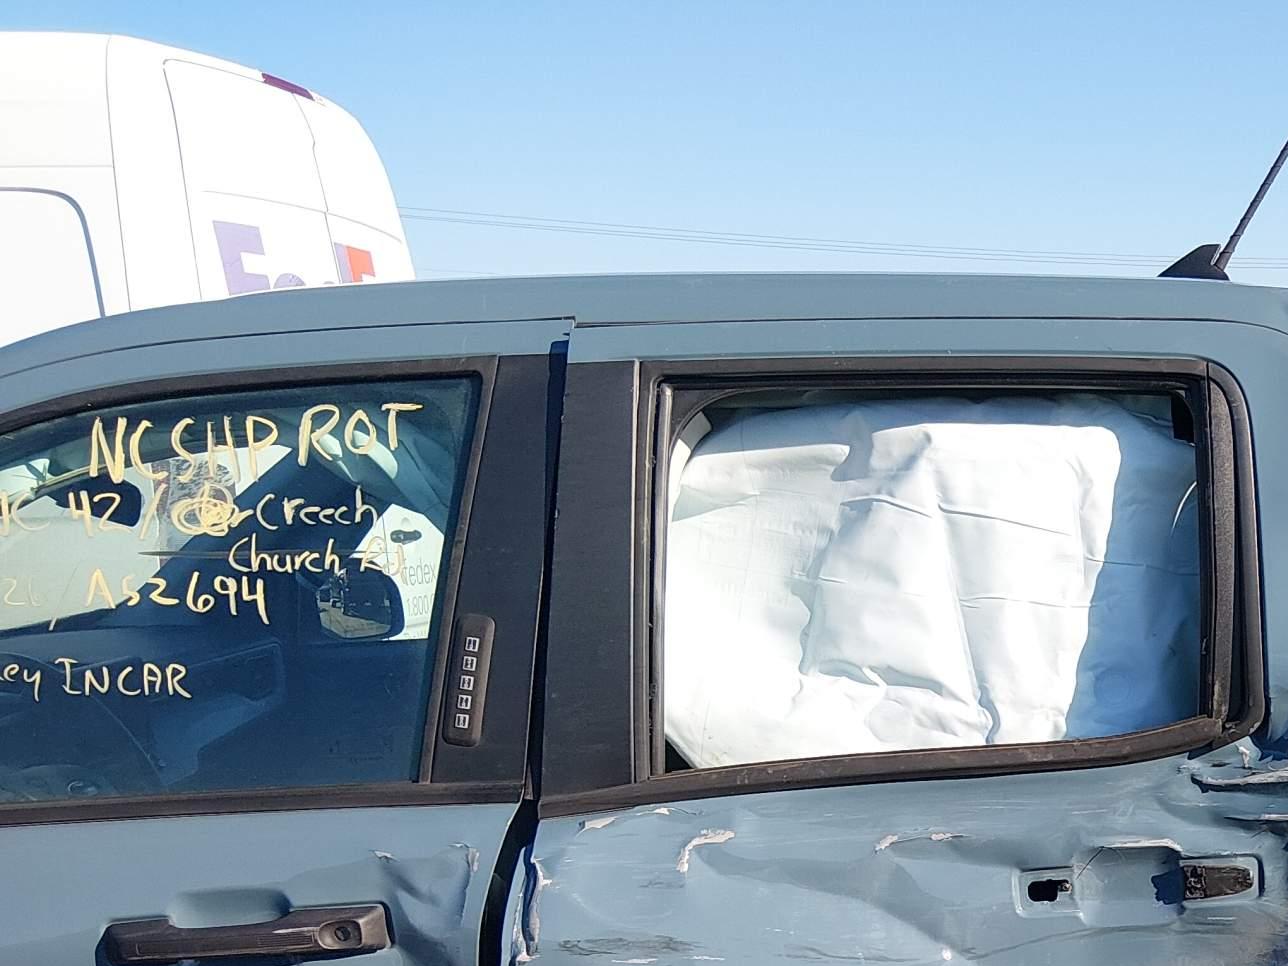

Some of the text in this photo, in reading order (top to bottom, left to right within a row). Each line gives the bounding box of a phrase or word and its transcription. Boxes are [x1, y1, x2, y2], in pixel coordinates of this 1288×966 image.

[256, 484, 378, 531] Creech
[228, 533, 343, 573] Church
[0, 663, 42, 702] ey
